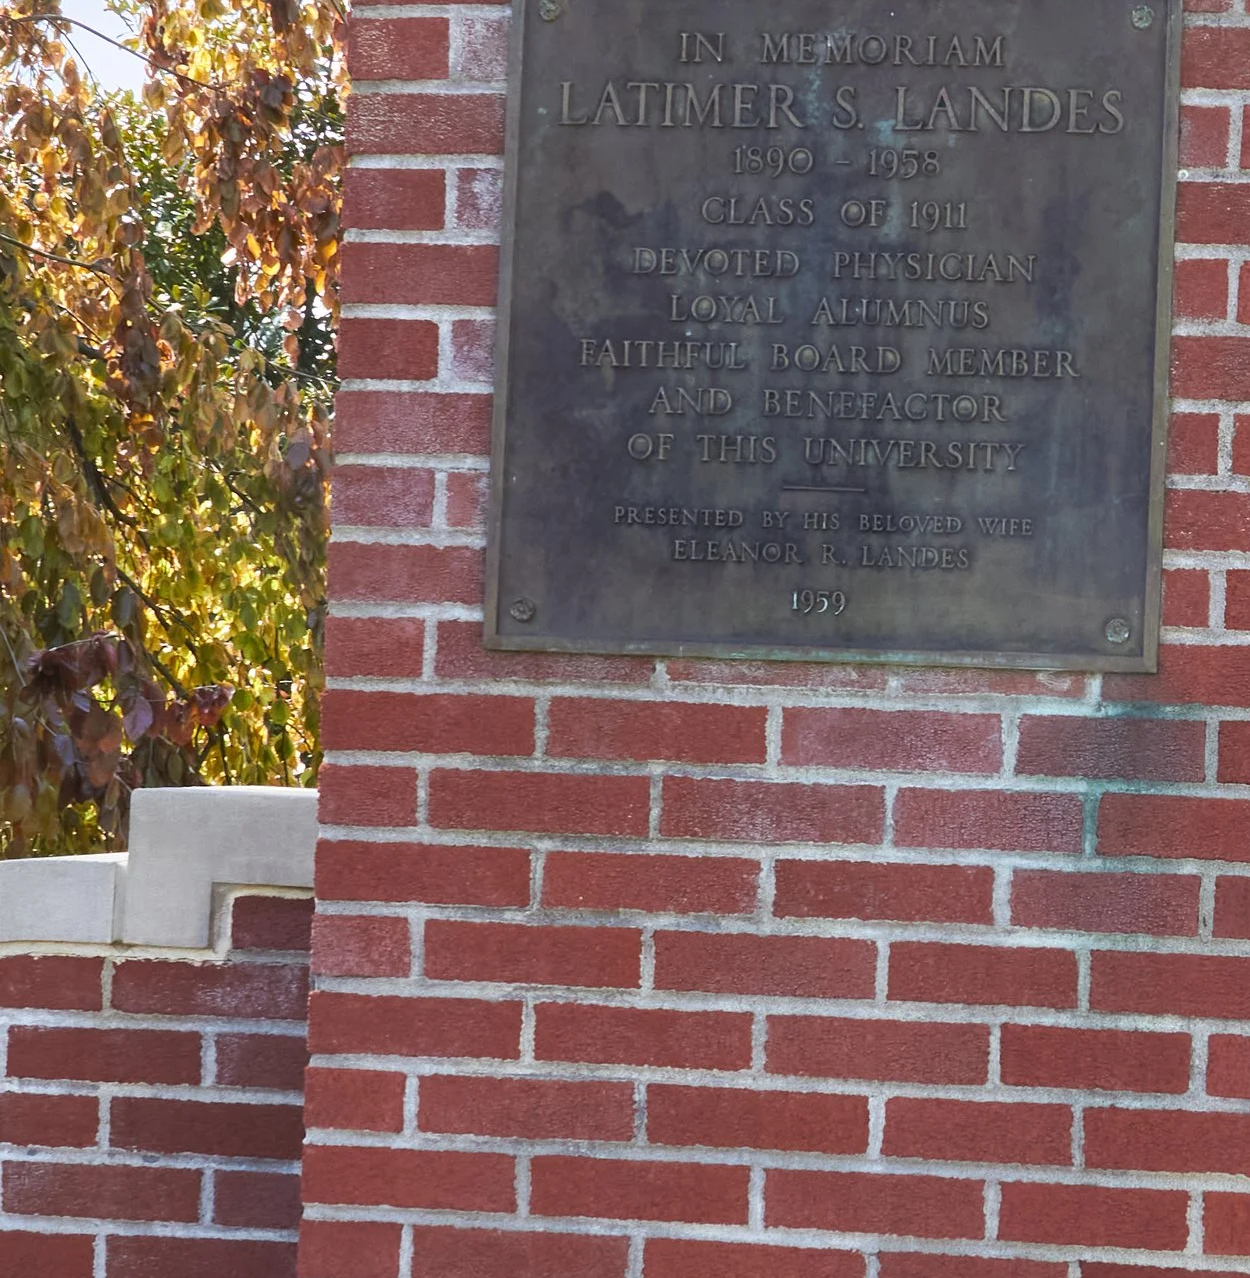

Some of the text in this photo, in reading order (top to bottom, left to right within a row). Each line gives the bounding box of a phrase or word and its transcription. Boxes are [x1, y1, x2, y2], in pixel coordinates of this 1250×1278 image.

[679, 32, 1004, 67] IN MEMORIAM
[558, 81, 1124, 134] LATIMER S. LANDES
[733, 145, 813, 177] 1890
[868, 149, 940, 179] 1958
[701, 196, 968, 232] CLASS OF 1911
[632, 247, 1037, 283] DEVOTED PHYSICIAN
[670, 294, 990, 329] LOYAL ALUMNUS
[578, 338, 1080, 378] FAITHFUL BOARD MEMBER
[648, 386, 1006, 423] AND BENEFACTOR
[627, 432, 1026, 471] OF THIS UNIVERSITY
[613, 505, 1034, 536] PRESENTED BY HIS BELOVED WIFE
[673, 539, 970, 570] ELEANOR R. LANDES
[791, 589, 846, 617] 1959
